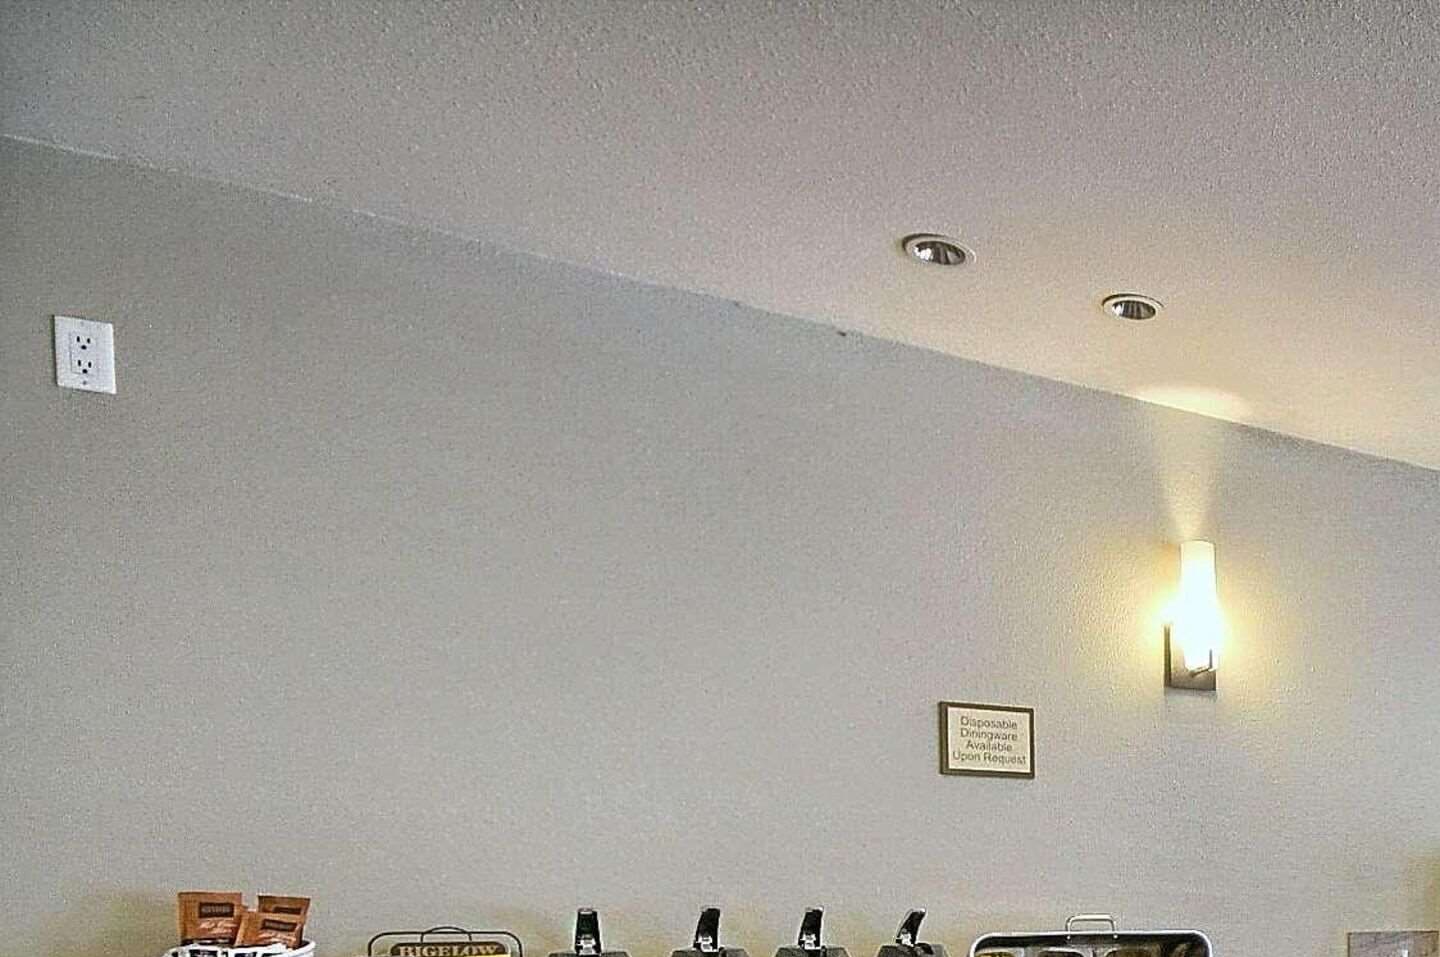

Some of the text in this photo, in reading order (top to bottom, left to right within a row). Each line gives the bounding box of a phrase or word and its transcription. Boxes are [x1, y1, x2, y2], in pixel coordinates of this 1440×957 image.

[960, 715, 1018, 730] Disposable
[960, 727, 1018, 741] Diningware
[966, 740, 1013, 752] Available
[952, 750, 1026, 765] Upon Request
[399, 945, 497, 957] BIGELOW
